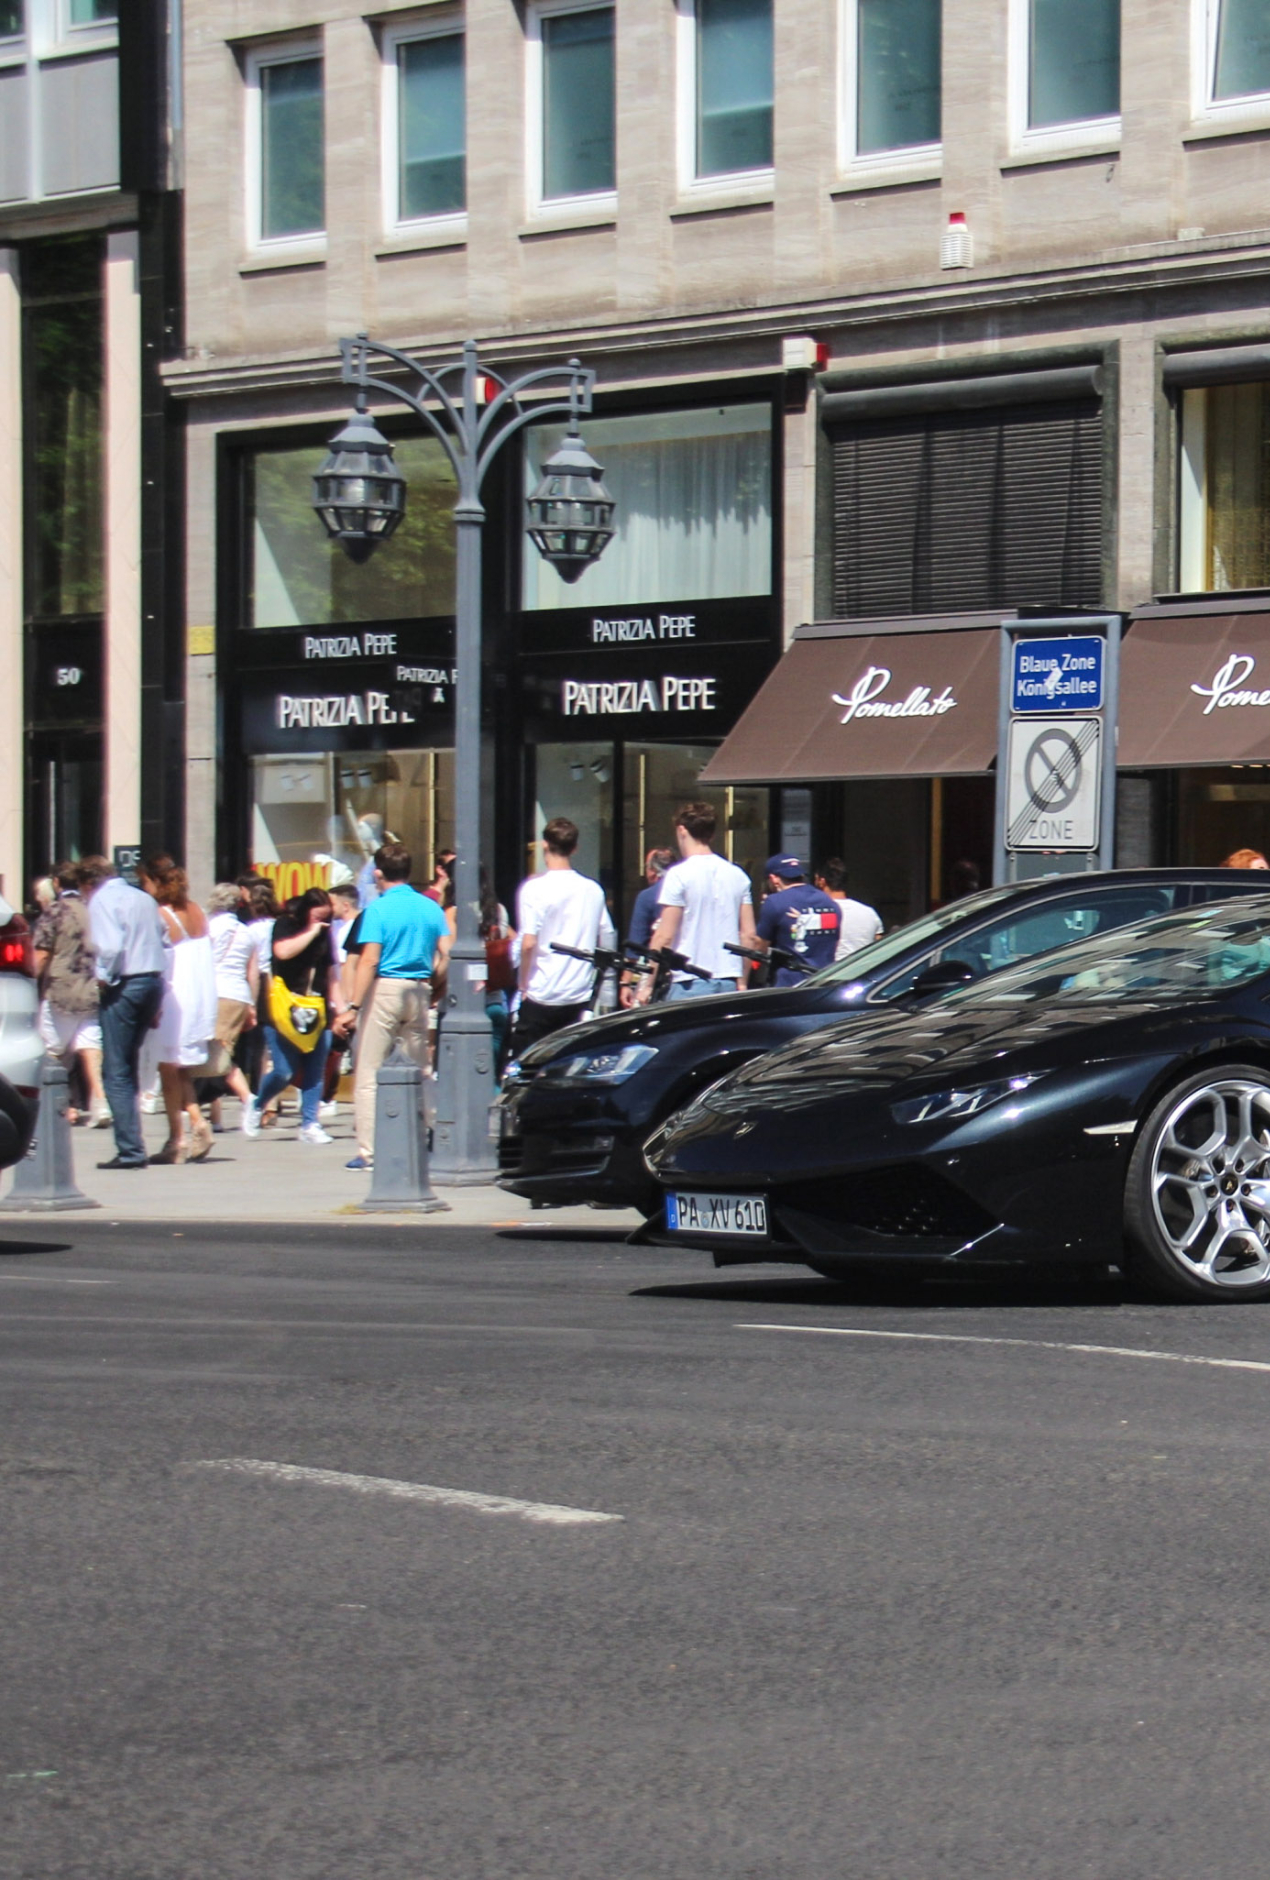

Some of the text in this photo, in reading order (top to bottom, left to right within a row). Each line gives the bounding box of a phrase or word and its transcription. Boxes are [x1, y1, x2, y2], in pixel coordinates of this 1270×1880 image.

[592, 615, 696, 643] PATRIZIA PEPE
[305, 633, 398, 659] PATRIZIA PEPE
[57, 668, 80, 685] 50
[1020, 654, 1097, 673] Blaue Zone
[563, 676, 716, 715] PATRIZIA PEPE
[831, 666, 958, 724] Pomellato
[279, 694, 362, 729] PATRIZIA
[1029, 820, 1073, 840] ZONE
[678, 1196, 765, 1231] PA XV 610
